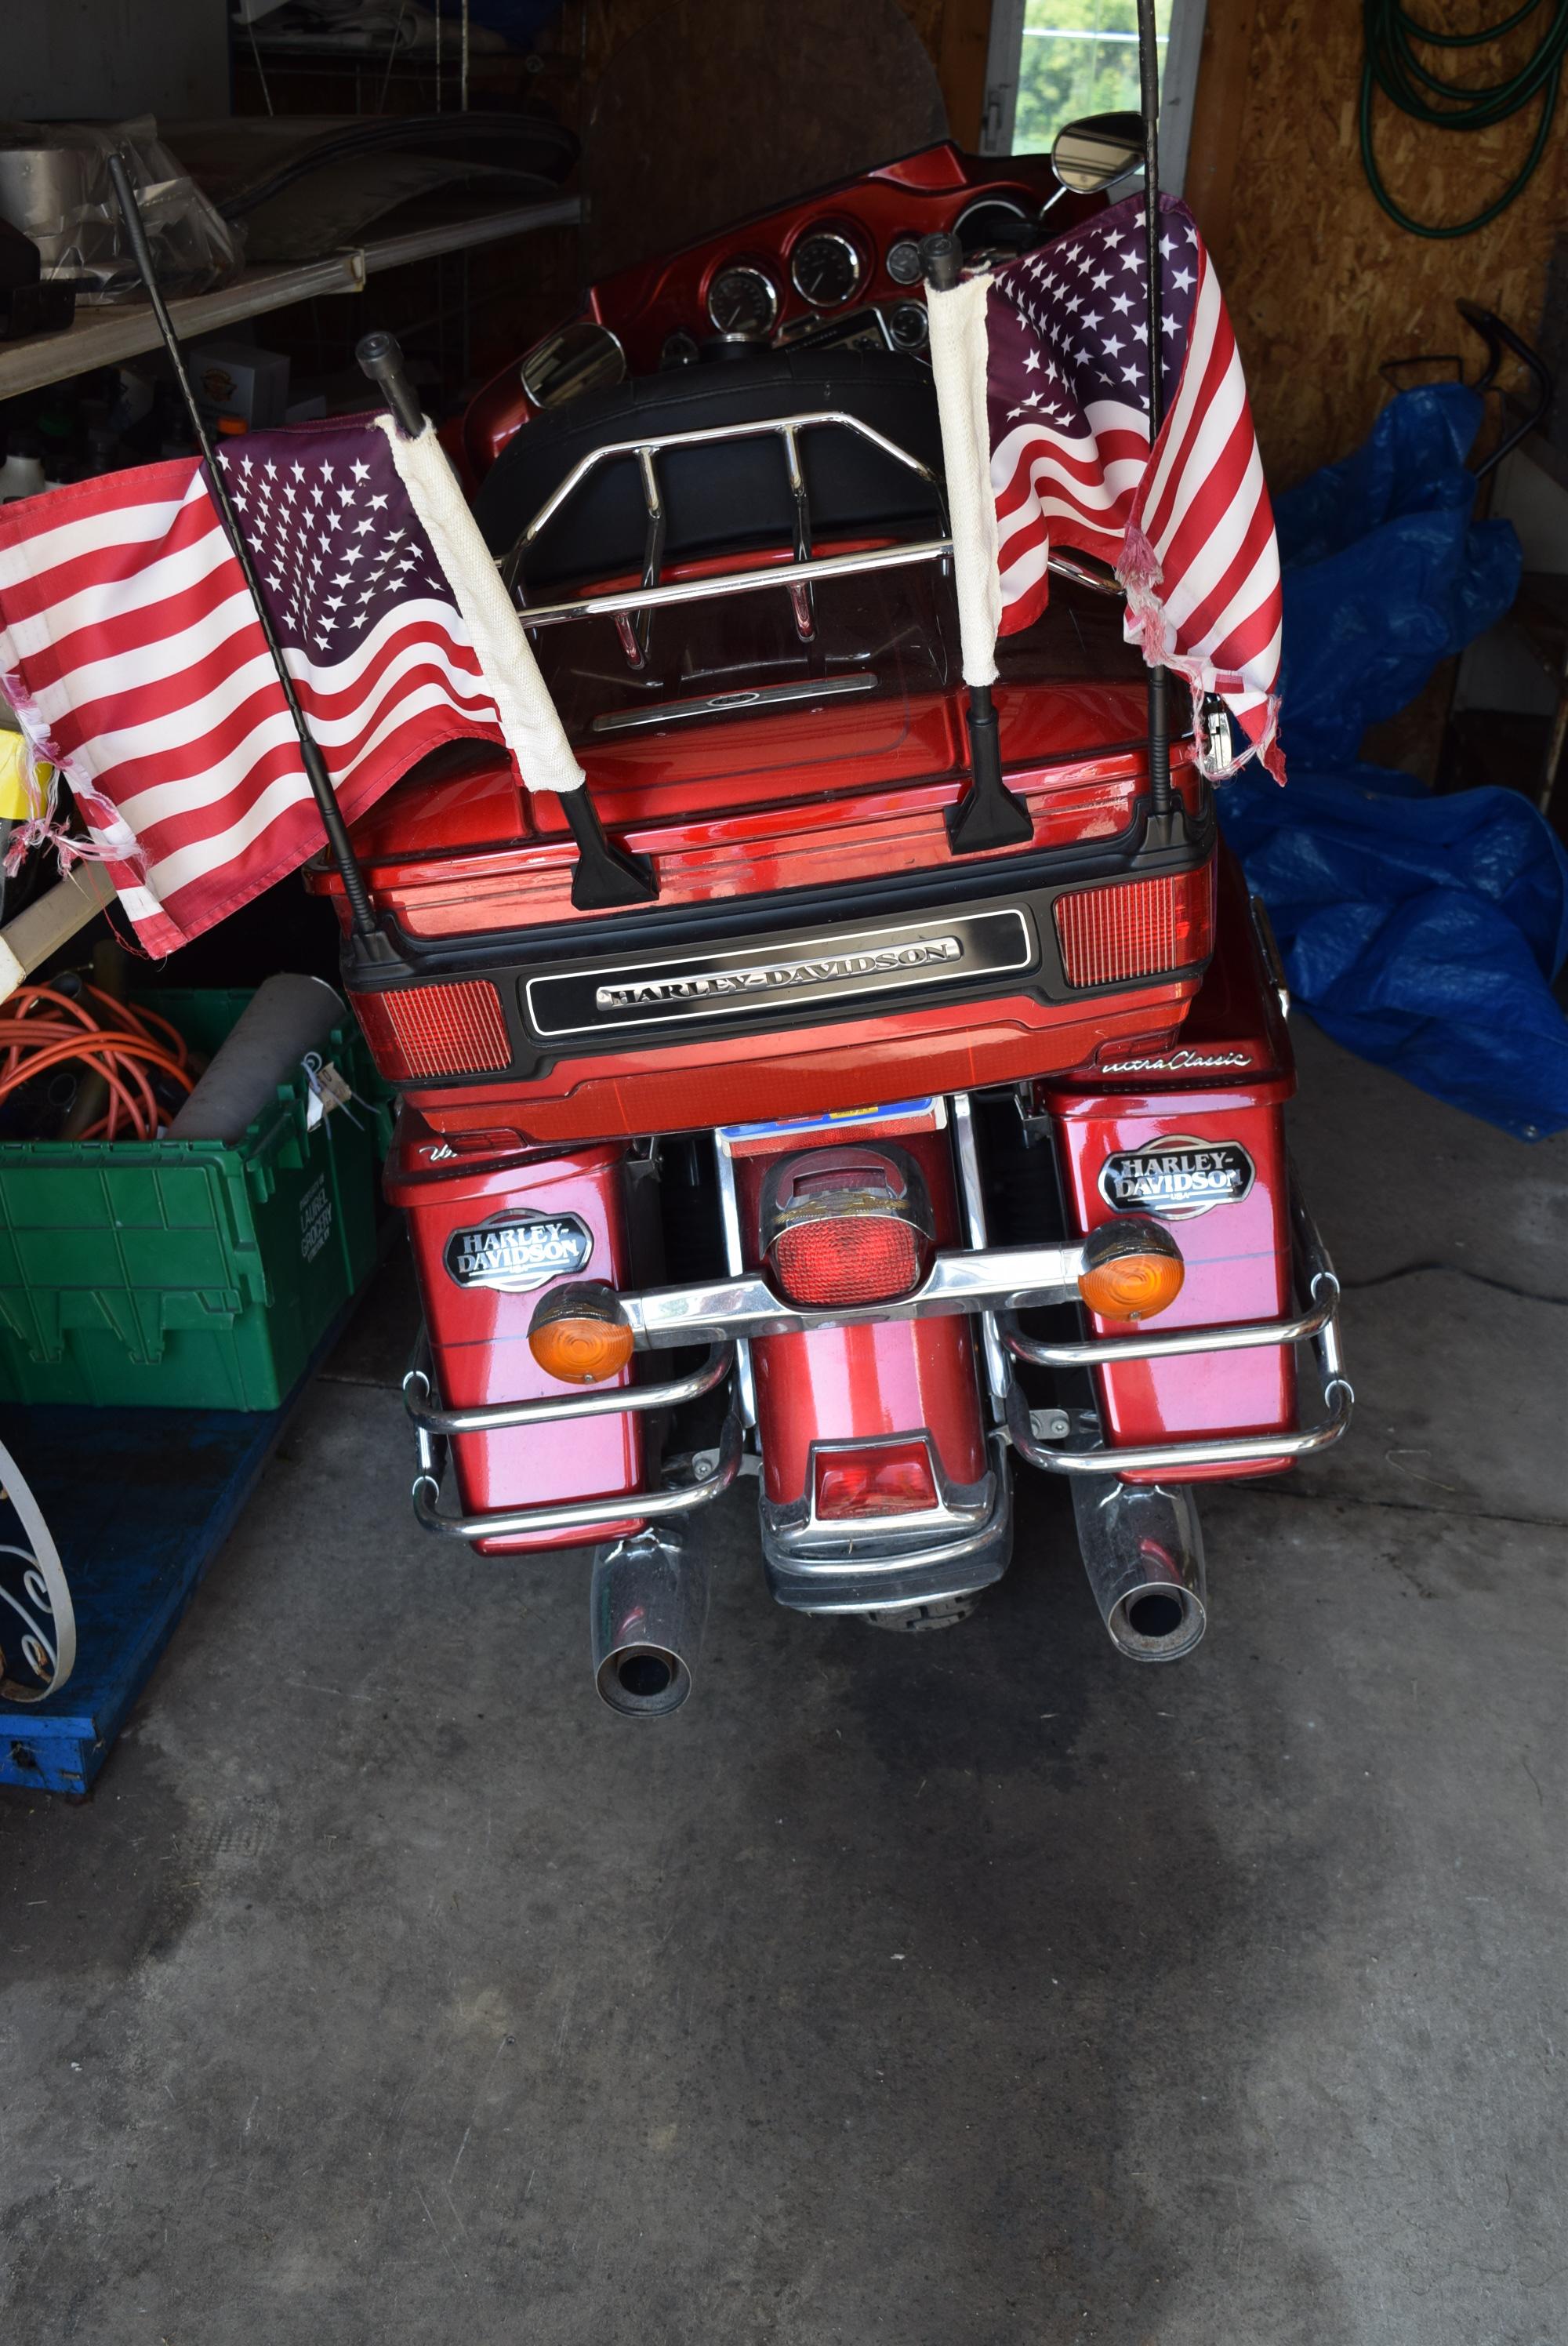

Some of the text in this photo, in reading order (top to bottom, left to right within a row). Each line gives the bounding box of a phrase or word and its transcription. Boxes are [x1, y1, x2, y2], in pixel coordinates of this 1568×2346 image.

[608, 943, 949, 1007] HARLEY-DAVIDSON
[1121, 1152, 1234, 1178] HARLEY-
[1114, 1169, 1242, 1198] DAVIDSON
[301, 1200, 332, 1258] GROCERY
[463, 1223, 569, 1254] HARLEY-
[456, 1239, 579, 1273] DAVIDSON
